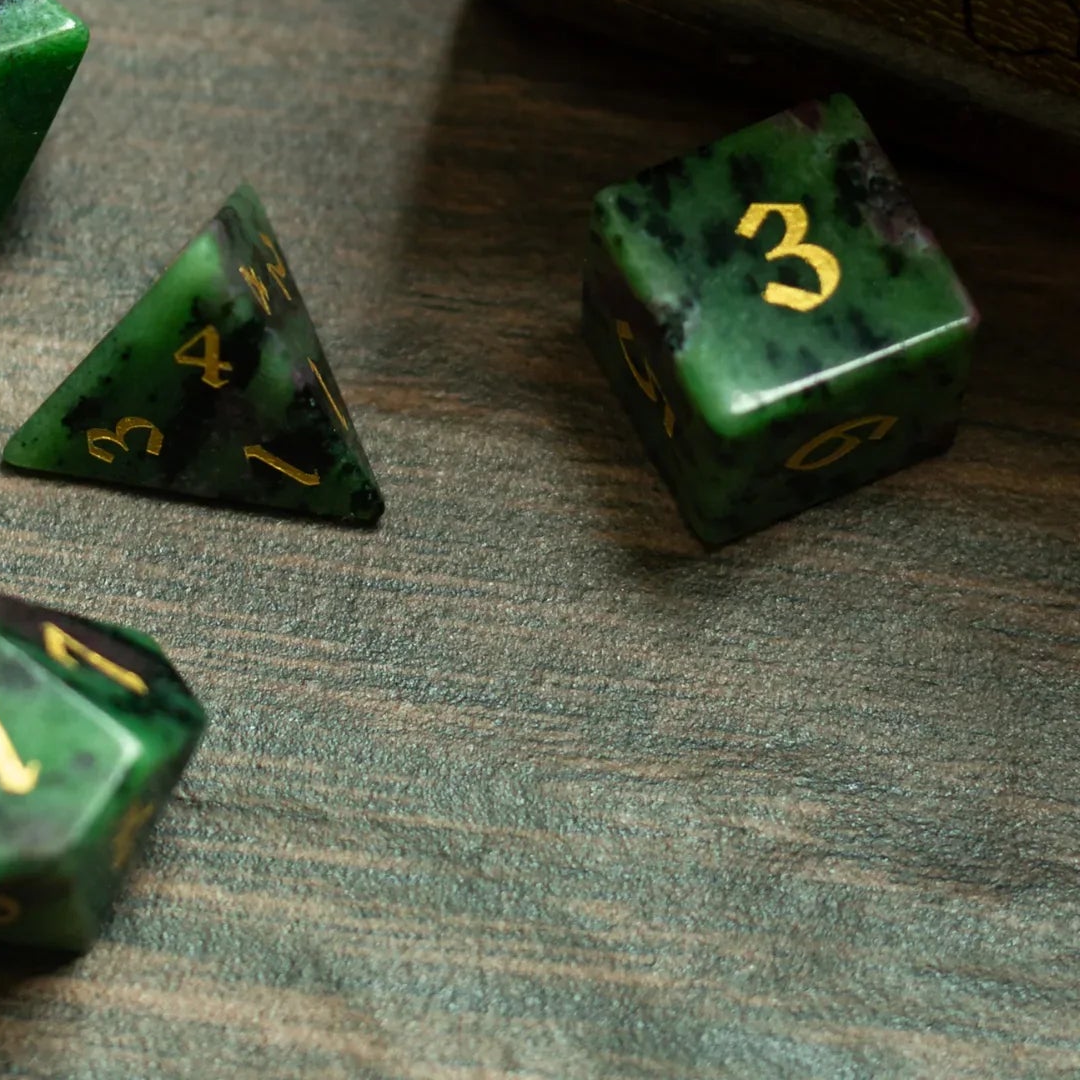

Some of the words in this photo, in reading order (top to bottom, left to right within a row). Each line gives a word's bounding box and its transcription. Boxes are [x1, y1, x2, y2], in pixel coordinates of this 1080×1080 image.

[735, 203, 841, 313] 3
[173, 325, 233, 389] 4
[86, 416, 164, 464] 3
[243, 444, 320, 486] 1
[785, 415, 898, 471] 6
